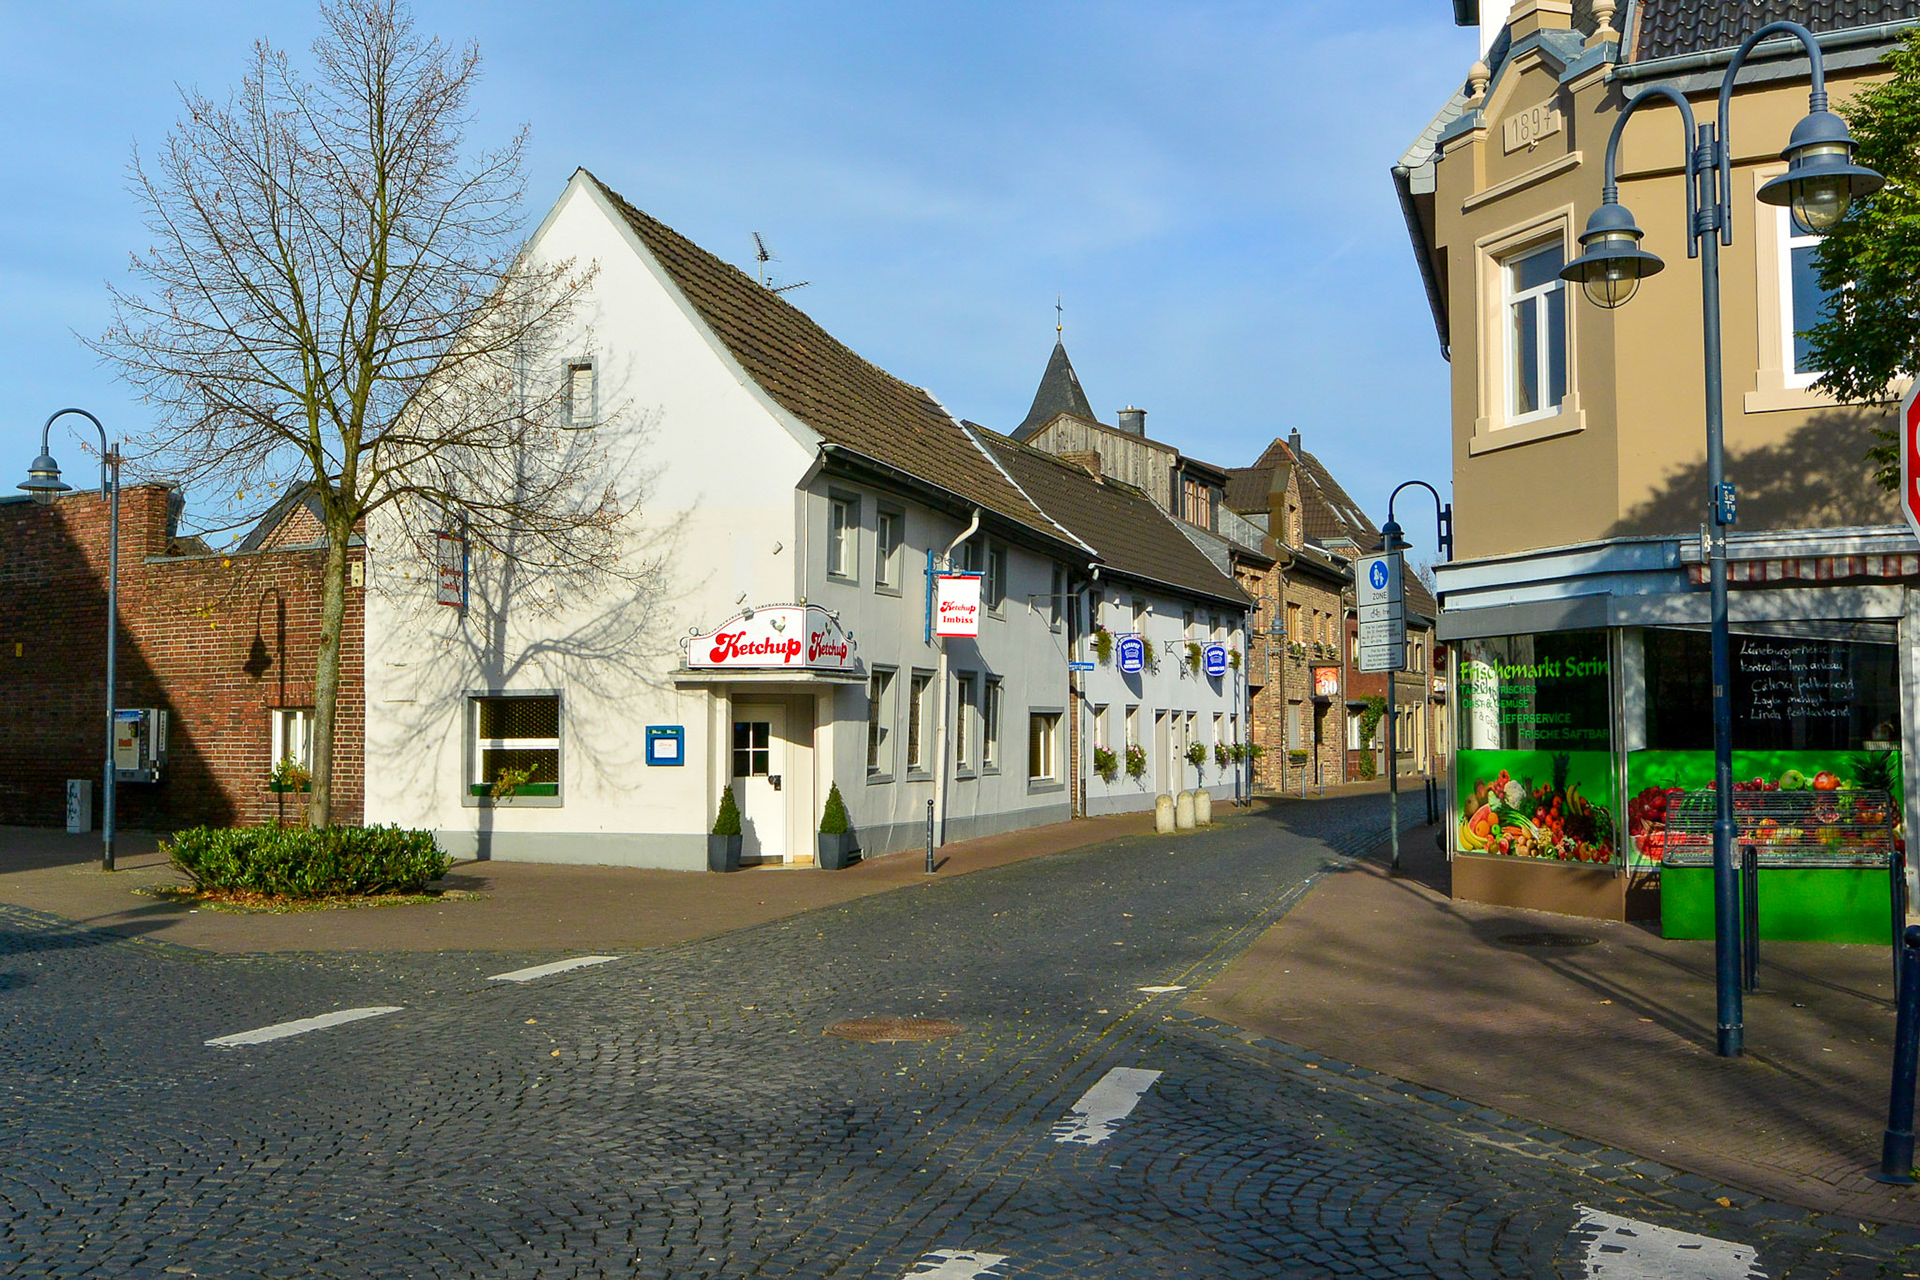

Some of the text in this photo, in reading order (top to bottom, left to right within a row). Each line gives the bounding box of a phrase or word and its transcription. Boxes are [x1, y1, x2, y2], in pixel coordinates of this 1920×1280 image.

[1372, 591, 1387, 600] ZONE
[940, 600, 977, 615] Ketchup
[943, 615, 974, 624] Imbiss
[709, 631, 802, 663] Ketchup
[808, 631, 848, 665] Ketchup
[1460, 656, 1609, 680] Frischemarkt Serin
[1321, 680, 1338, 694] 30
[1494, 697, 1529, 709] GEMÜSE
[1497, 712, 1571, 725] LIEFERSERVICE
[1519, 728, 1610, 740] FRISCHE SAFTBAR
